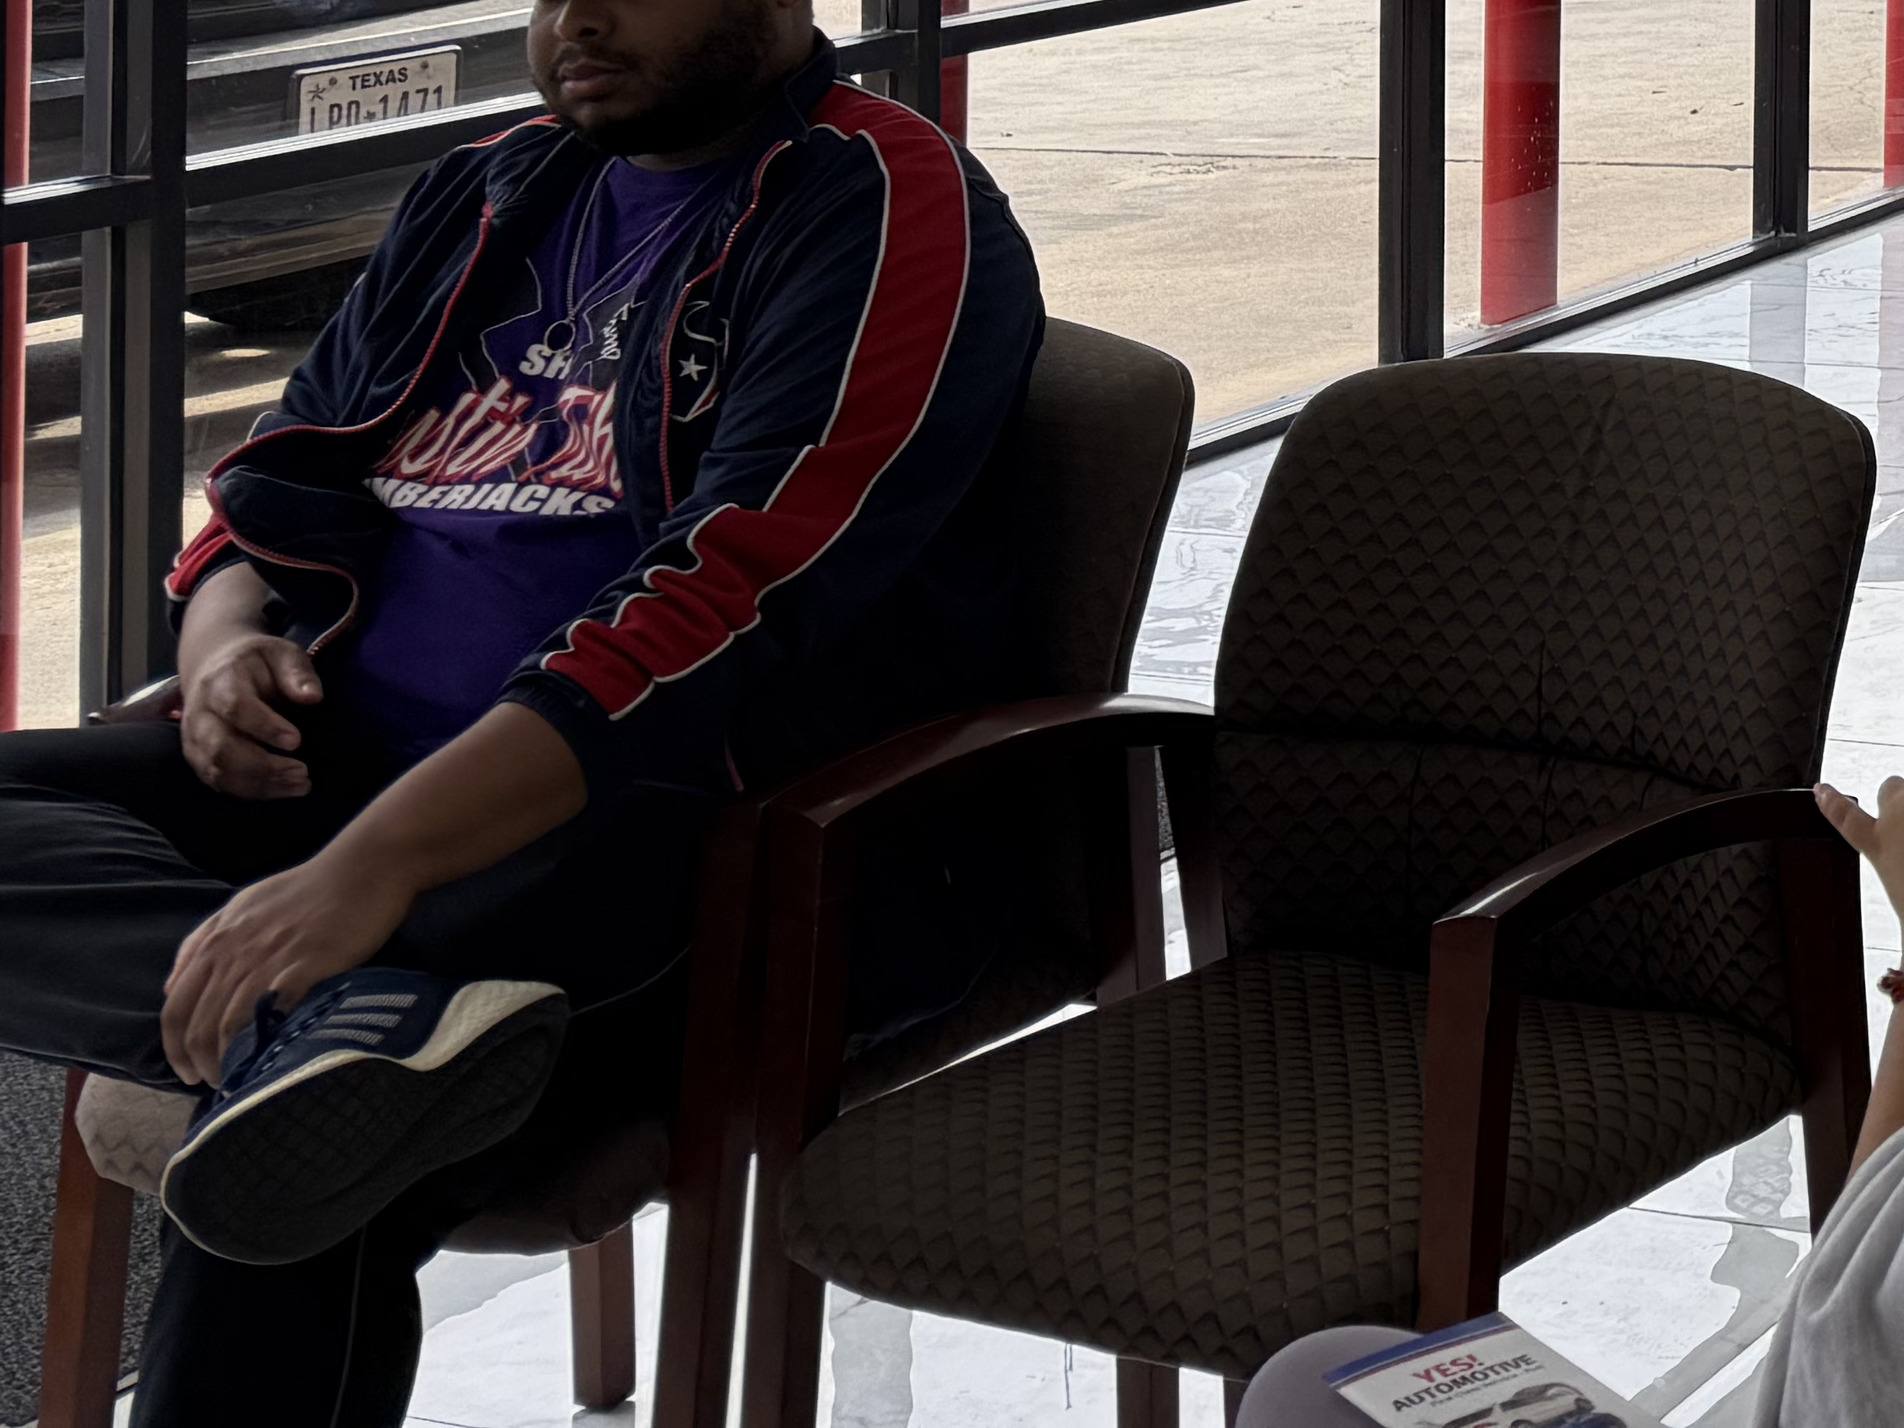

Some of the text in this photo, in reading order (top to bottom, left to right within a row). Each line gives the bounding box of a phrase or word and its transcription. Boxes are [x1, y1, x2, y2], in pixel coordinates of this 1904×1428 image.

[349, 66, 409, 92] TEXAS
[1391, 1353, 1539, 1412] AUTOMOTIVE
[1410, 1353, 1485, 1384] YES!
